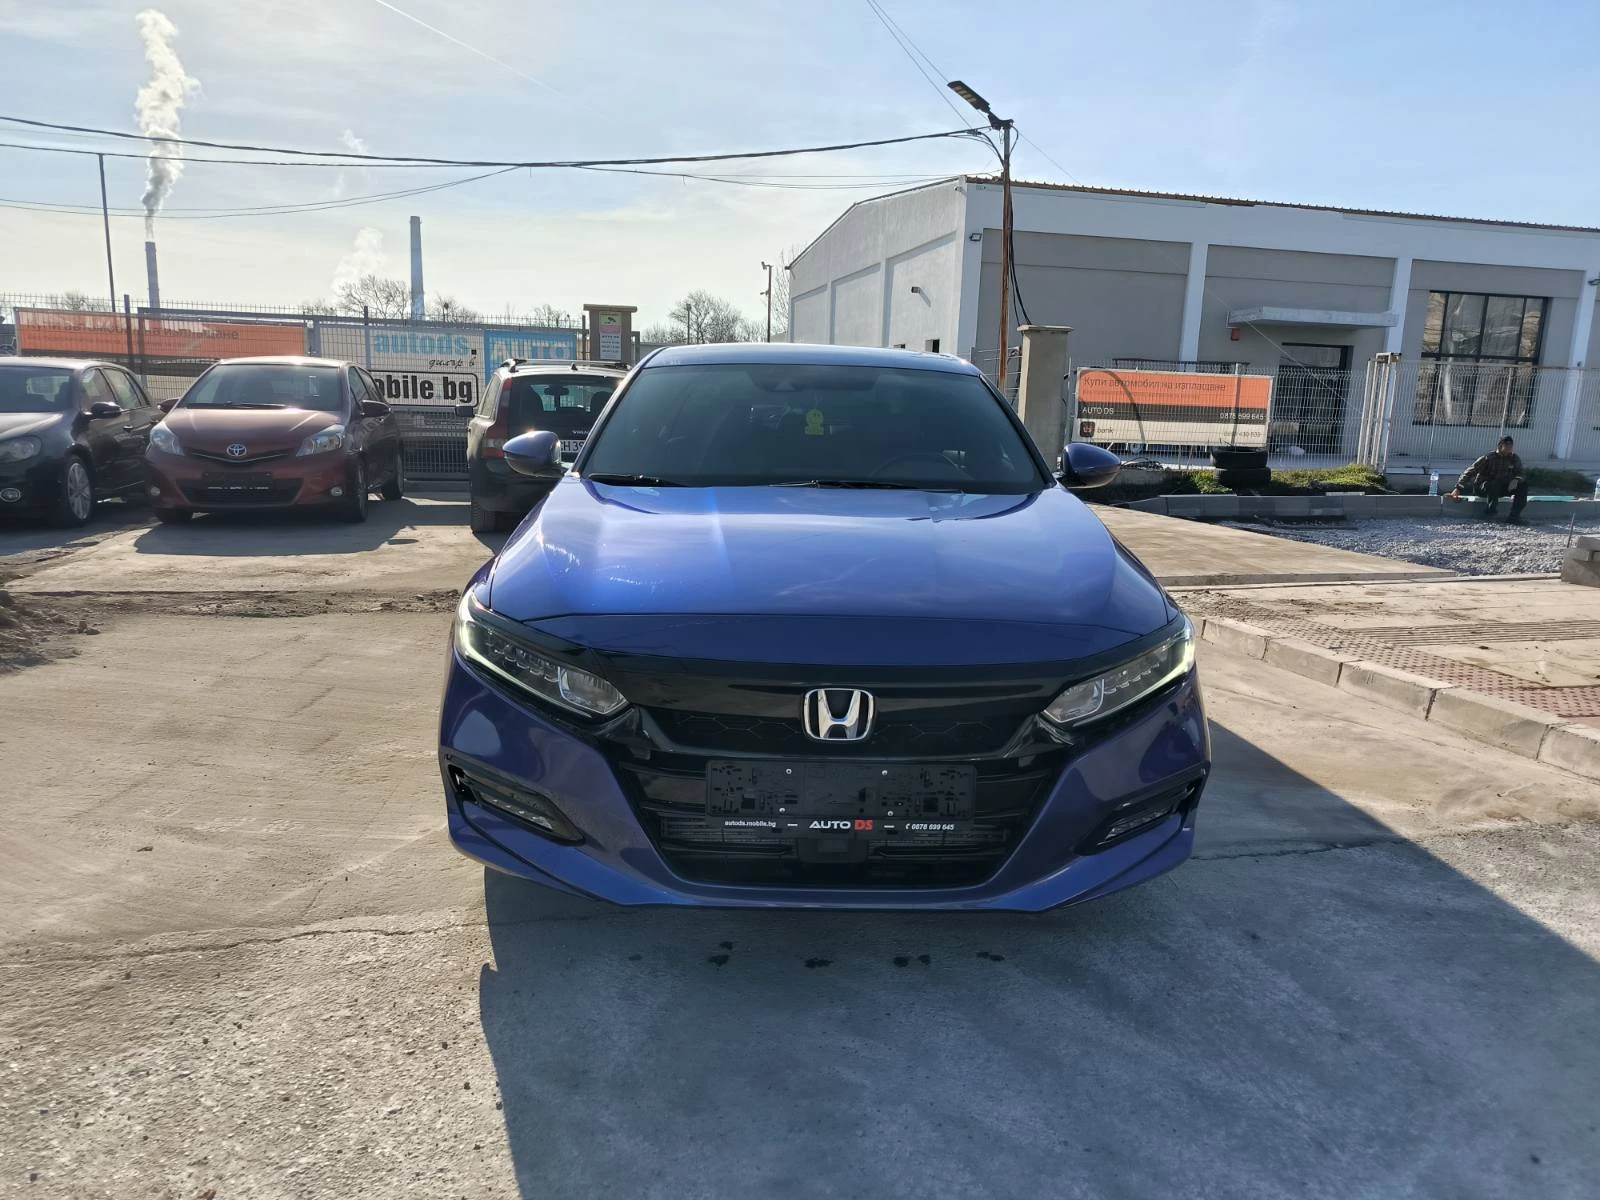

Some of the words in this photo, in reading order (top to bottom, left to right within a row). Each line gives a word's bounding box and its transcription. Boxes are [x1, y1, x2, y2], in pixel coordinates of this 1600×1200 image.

[374, 374, 473, 404] obile.bg
[1084, 377, 1107, 387] Купи
[1174, 381, 1226, 392] изплащане
[1082, 407, 1102, 415] AUTO
[808, 819, 851, 830] AUTO
[853, 819, 874, 831] DS
